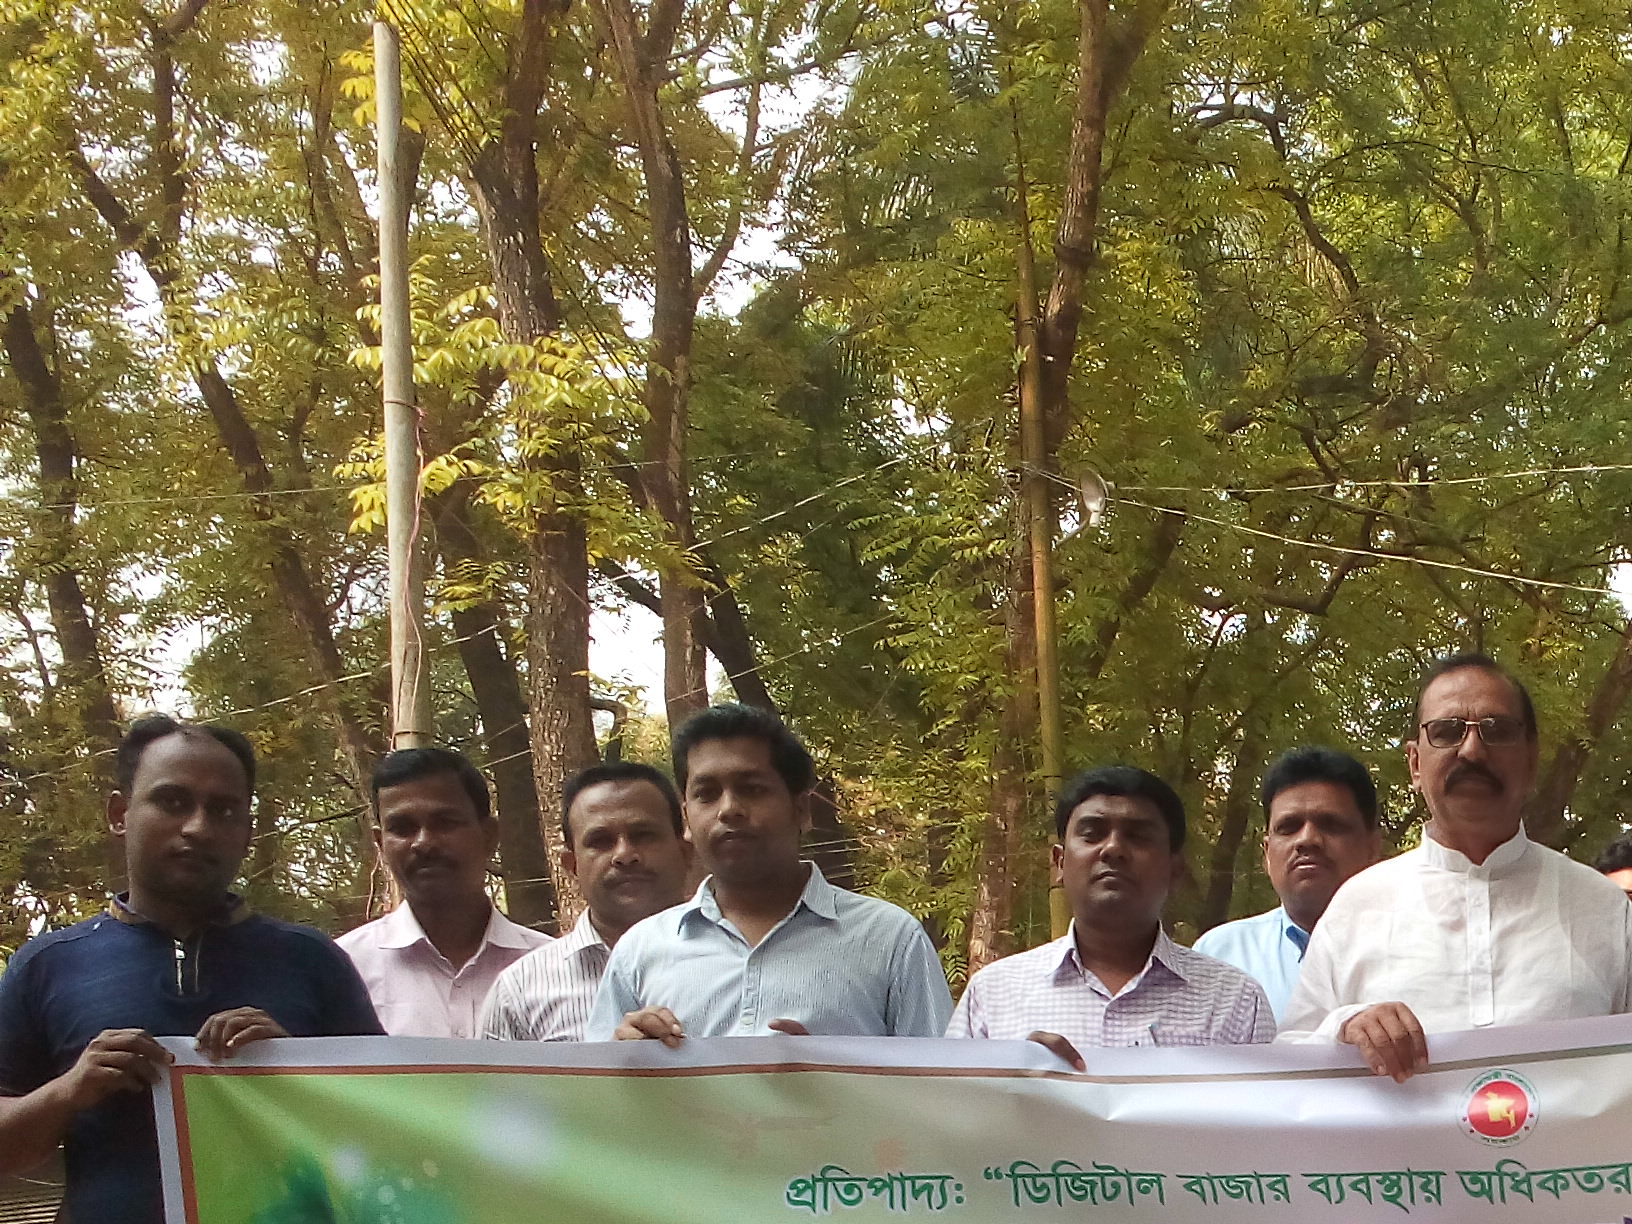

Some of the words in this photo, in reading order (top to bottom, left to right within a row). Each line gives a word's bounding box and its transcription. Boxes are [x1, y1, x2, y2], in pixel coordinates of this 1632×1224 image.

[786, 1164, 965, 1211] প্রতিপাদ্য:
[1183, 1168, 1290, 1205] বাজার
[1304, 1167, 1446, 1213] ব্যবস্থায়
